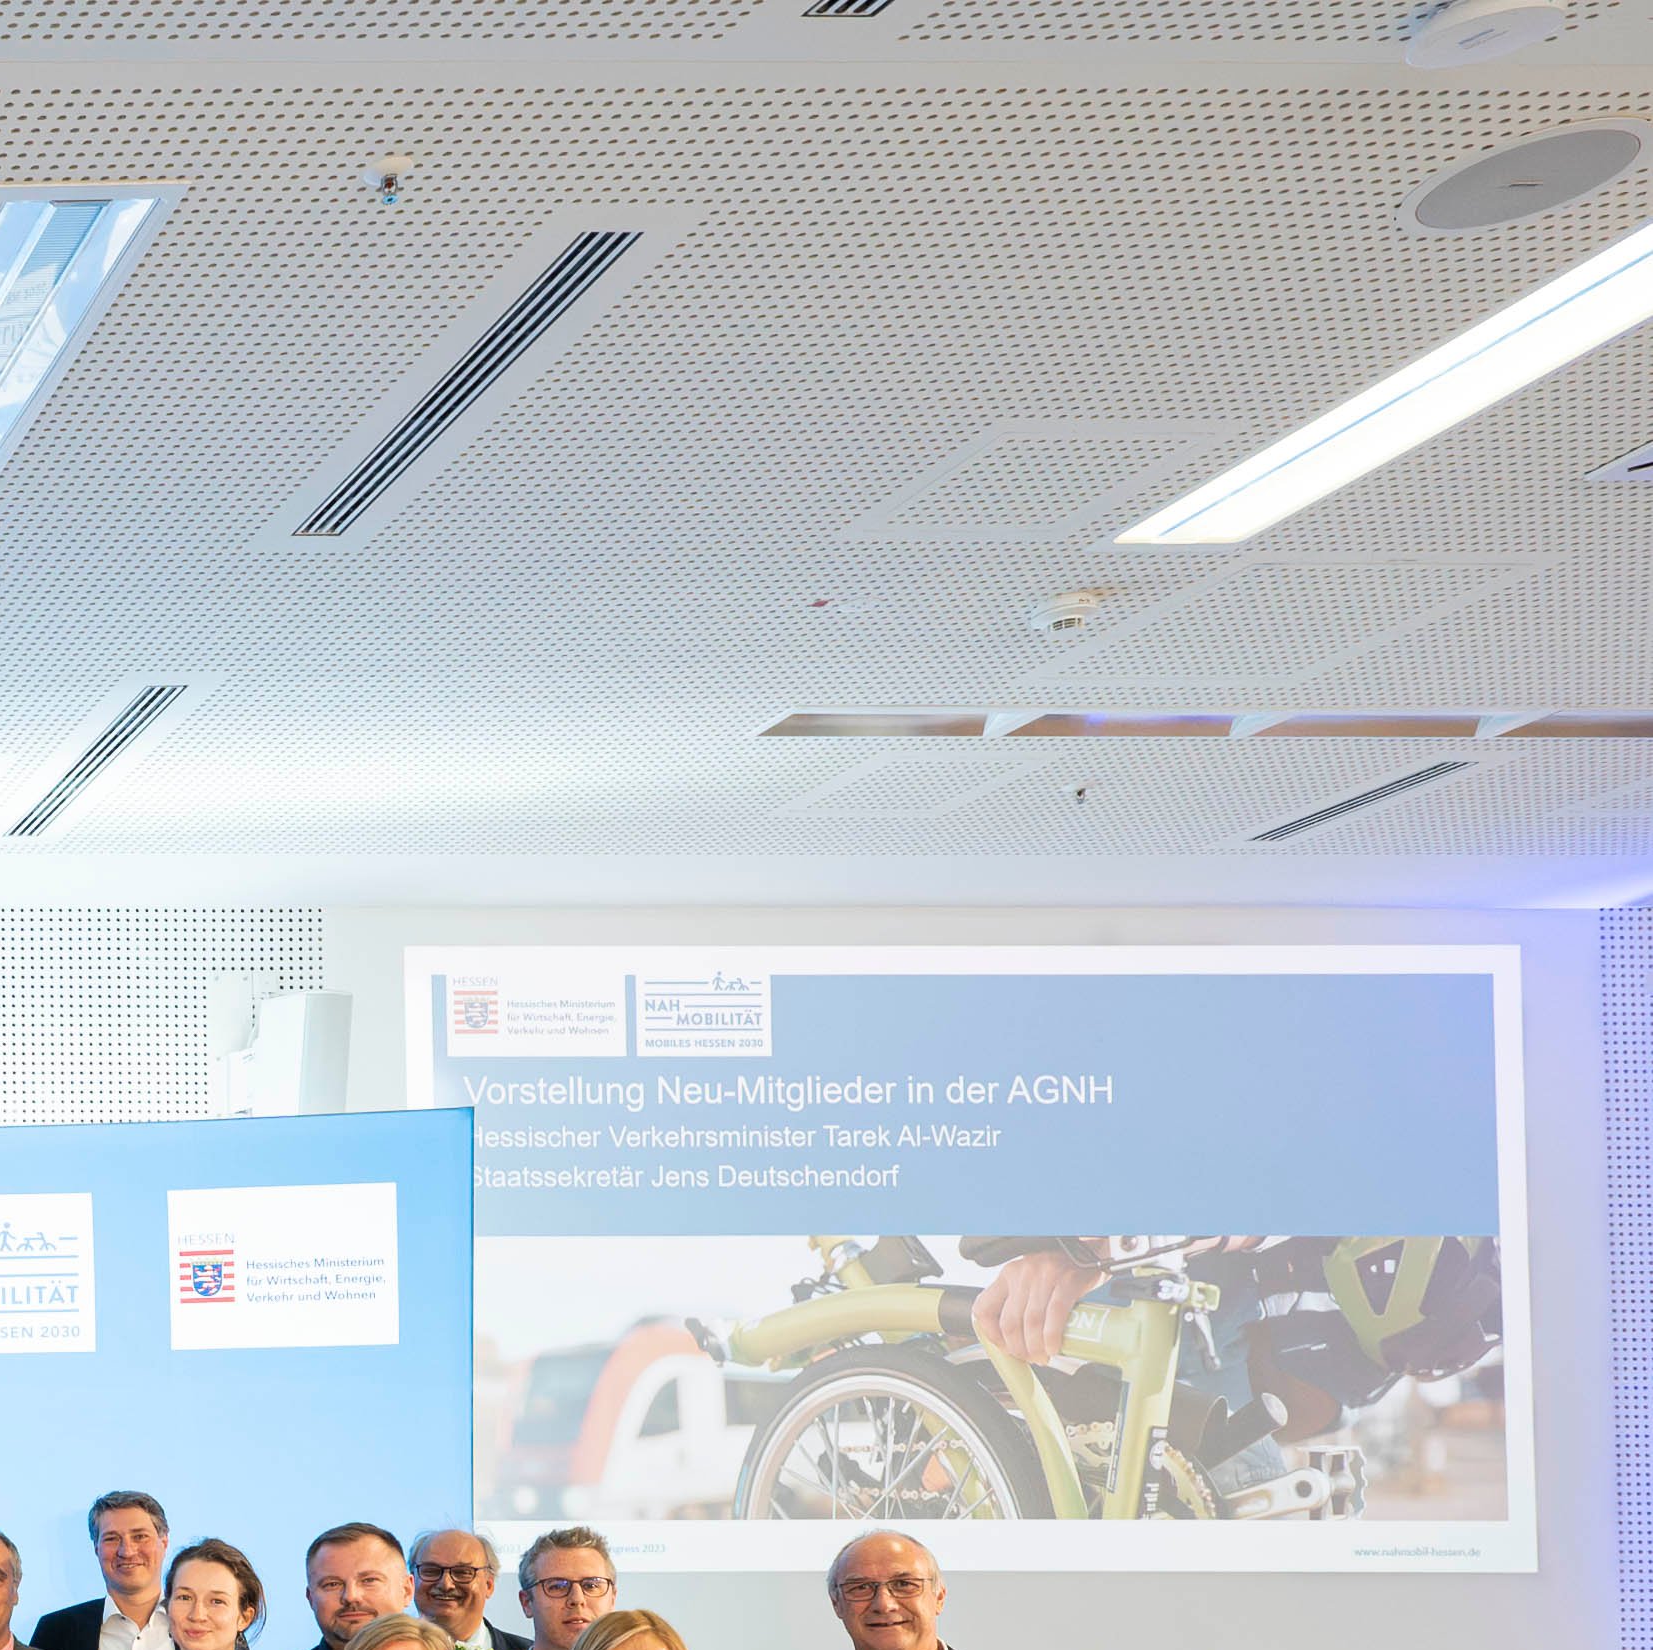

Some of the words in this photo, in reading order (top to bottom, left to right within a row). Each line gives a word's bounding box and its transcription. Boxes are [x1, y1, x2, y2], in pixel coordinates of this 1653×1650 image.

[453, 977, 499, 987] HESSEN
[645, 999, 681, 1012] NAH
[676, 1008, 763, 1026] MOBILITÄT
[644, 1039, 692, 1048] MOBILES
[694, 1039, 736, 1048] HESSEN
[738, 1039, 764, 1048] 2030
[463, 1075, 645, 1112] Vorstellung
[657, 1075, 897, 1112] Neu-Mitglieder
[907, 1075, 935, 1105] in
[945, 1075, 1000, 1105] der
[1007, 1075, 1113, 1105] AGNH
[608, 1125, 817, 1148] Verkehrsminister
[822, 1124, 892, 1148] Tarek
[896, 1124, 1002, 1148] Al-Wazir
[651, 1165, 710, 1188] Jens
[717, 1164, 901, 1188] Deutschendorf
[176, 1232, 236, 1246] HESSEN
[246, 1258, 310, 1271] Hessisches
[313, 1256, 385, 1269] Ministerium
[246, 1274, 262, 1287] für
[265, 1273, 331, 1287] Wirtschaft,
[335, 1271, 386, 1287] Energie,
[246, 1290, 294, 1304] Verkehr
[297, 1290, 321, 1302] und
[324, 1288, 377, 1301] Wohnen
[40, 1325, 81, 1340] 2030
